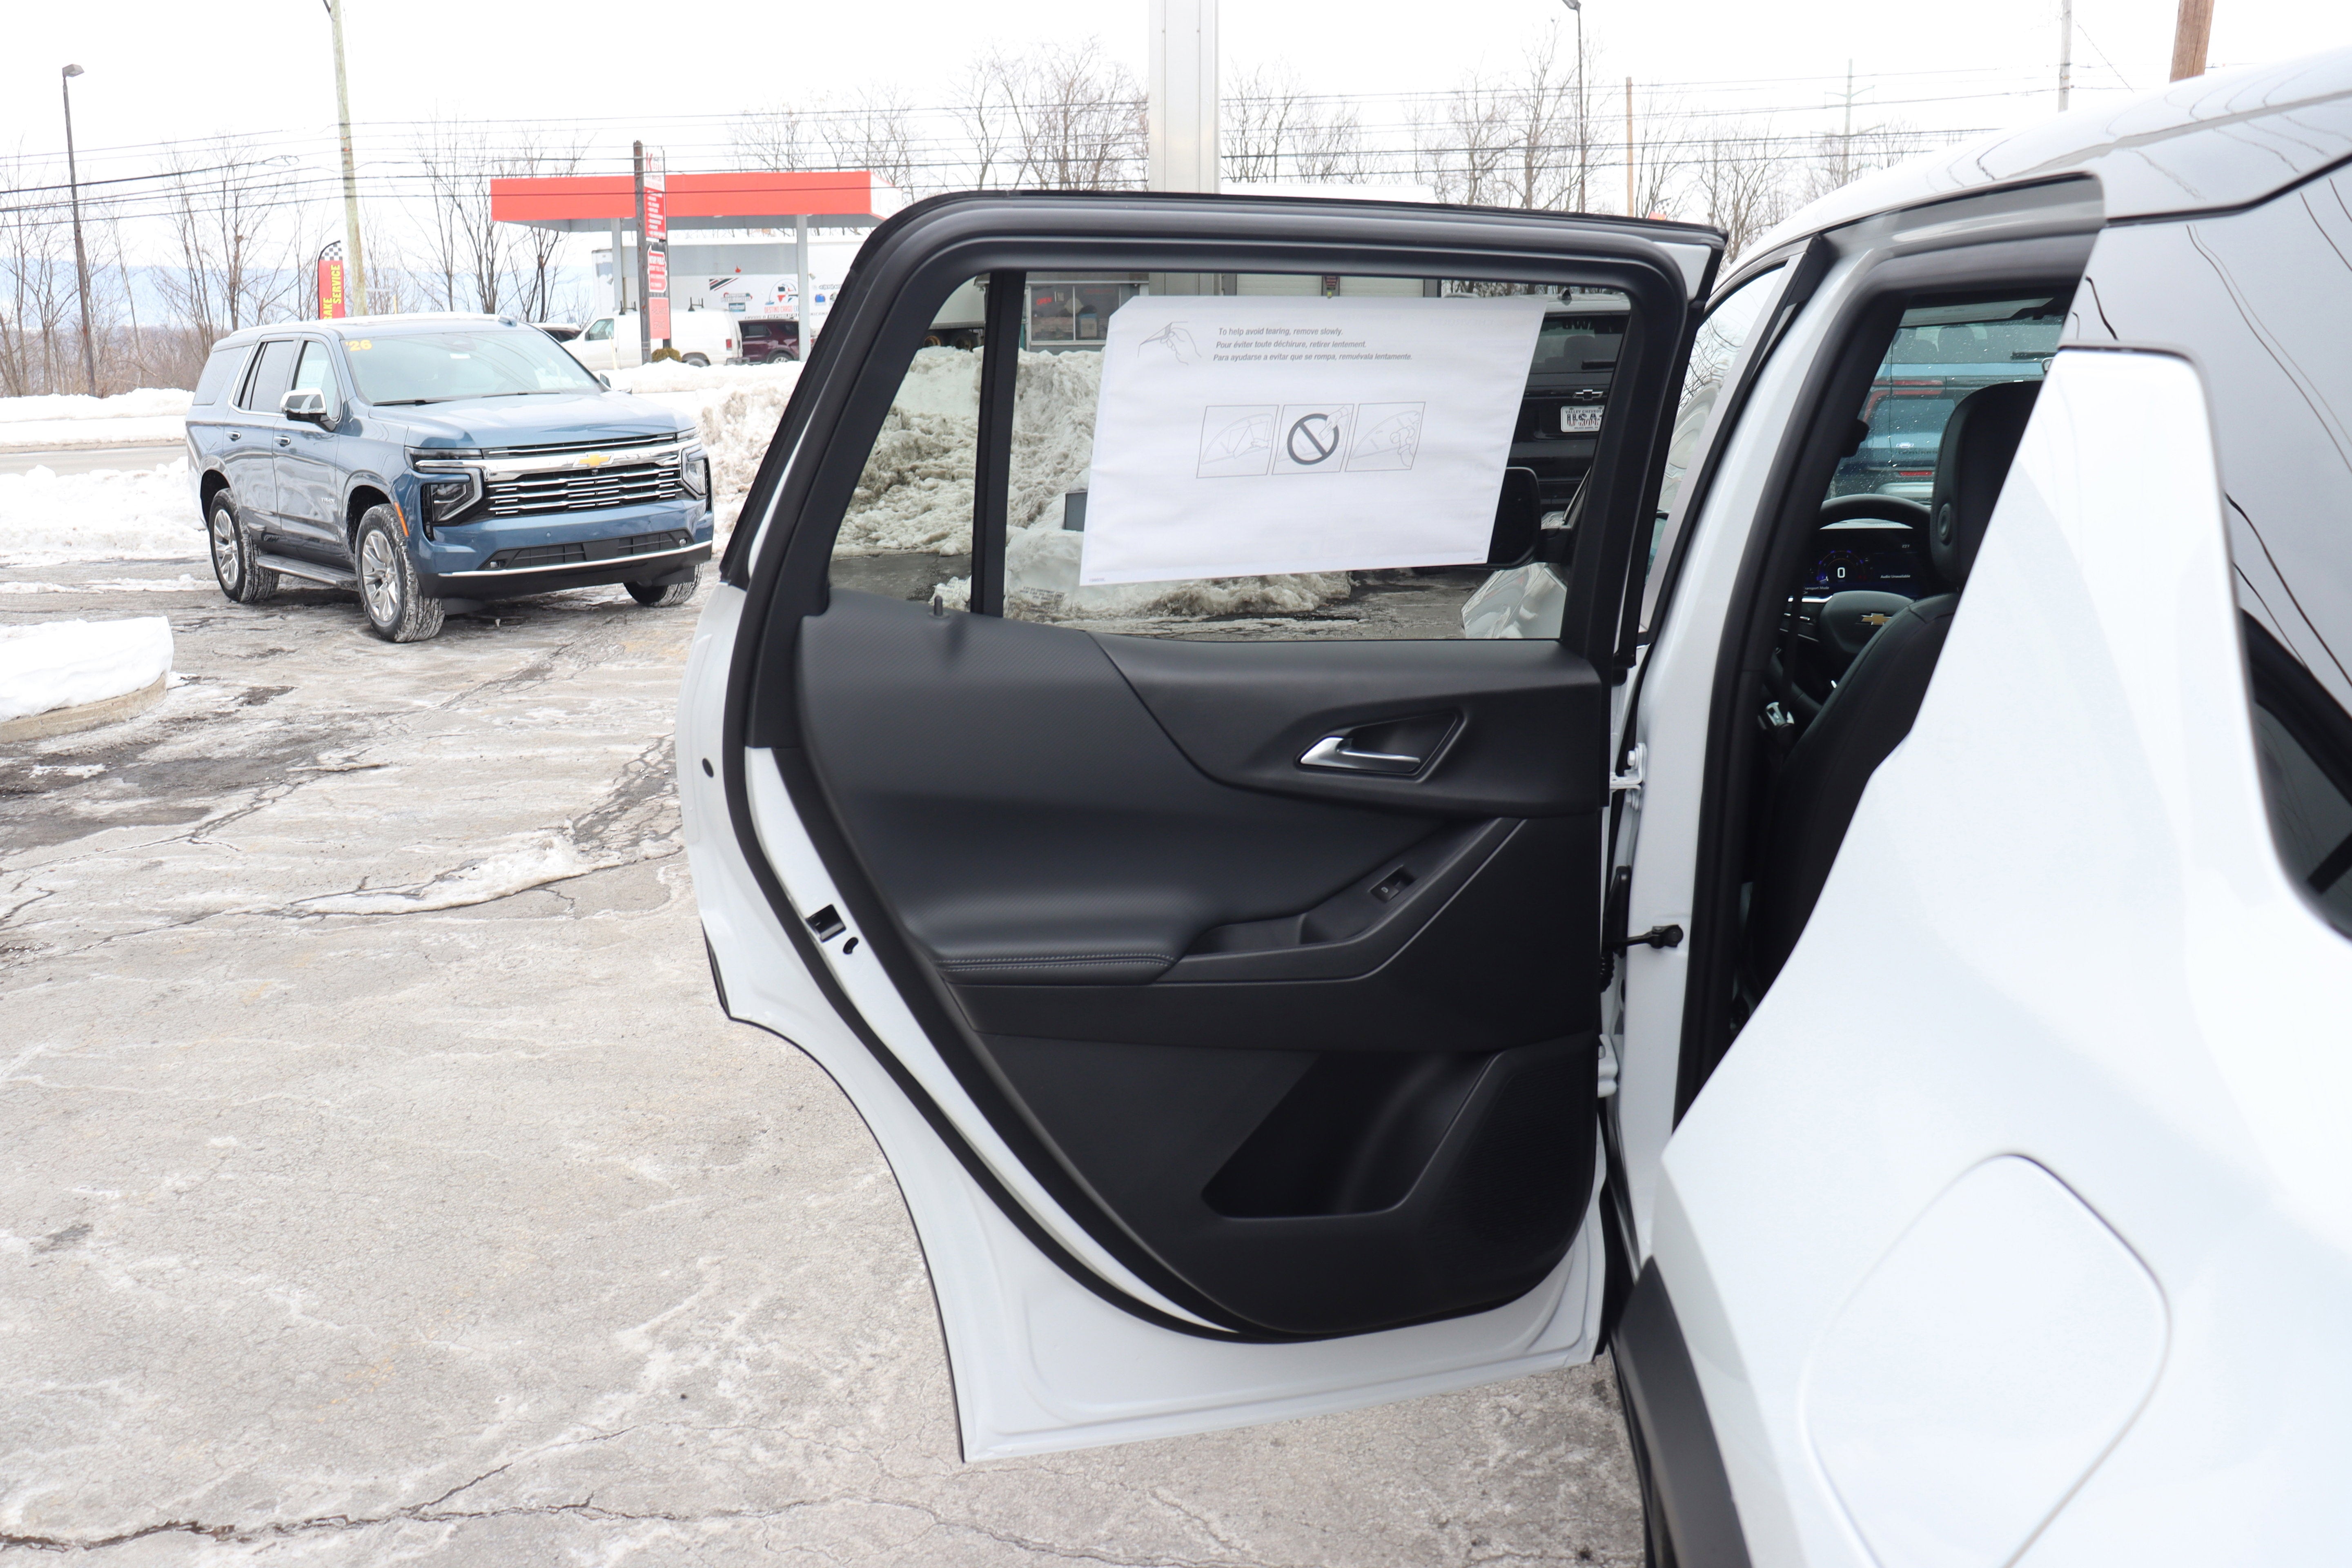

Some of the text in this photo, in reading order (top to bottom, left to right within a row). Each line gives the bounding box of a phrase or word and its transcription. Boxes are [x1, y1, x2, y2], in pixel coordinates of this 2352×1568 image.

[330, 265, 342, 304] SERVICE
[323, 297, 333, 319] RAKE
[1229, 327, 1244, 336] help
[1266, 327, 1291, 336] tearing,
[1320, 327, 1343, 337] slowly.
[345, 339, 373, 352] '26
[1274, 340, 1307, 348] déchirure,
[1230, 354, 1261, 362] ayudarse
[1837, 567, 1846, 578] 0
